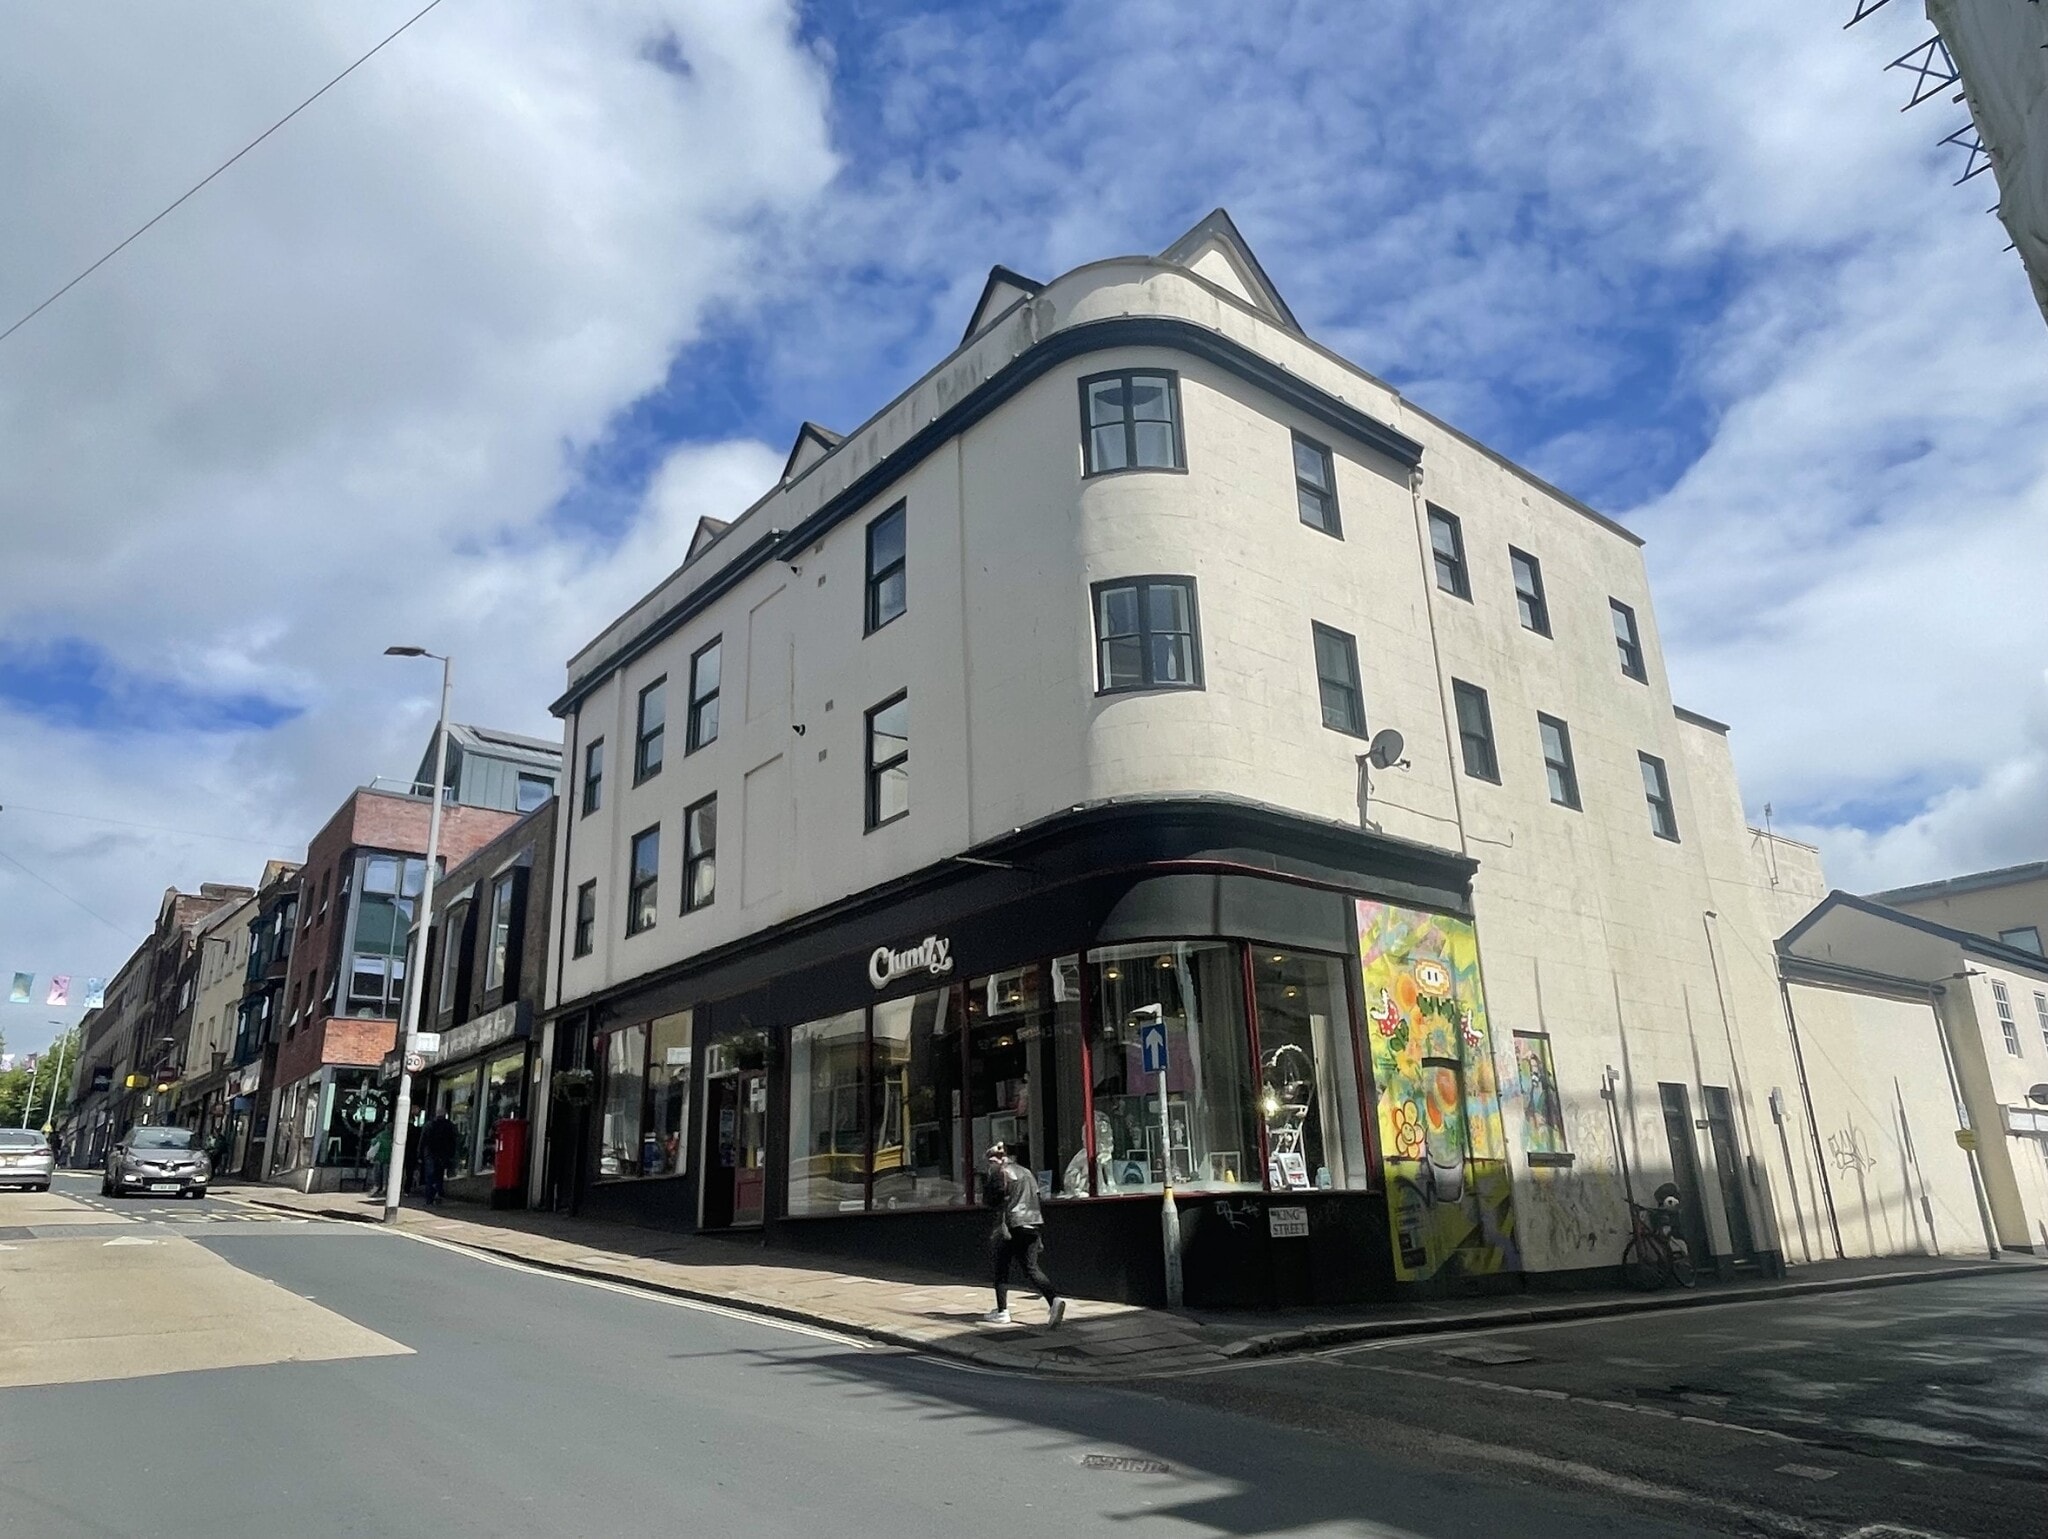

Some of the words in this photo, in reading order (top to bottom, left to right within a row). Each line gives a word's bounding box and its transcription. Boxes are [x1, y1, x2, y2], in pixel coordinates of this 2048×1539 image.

[407, 1058, 421, 1066] 20
[1277, 1209, 1300, 1220] KING
[1273, 1223, 1306, 1235] STREET
